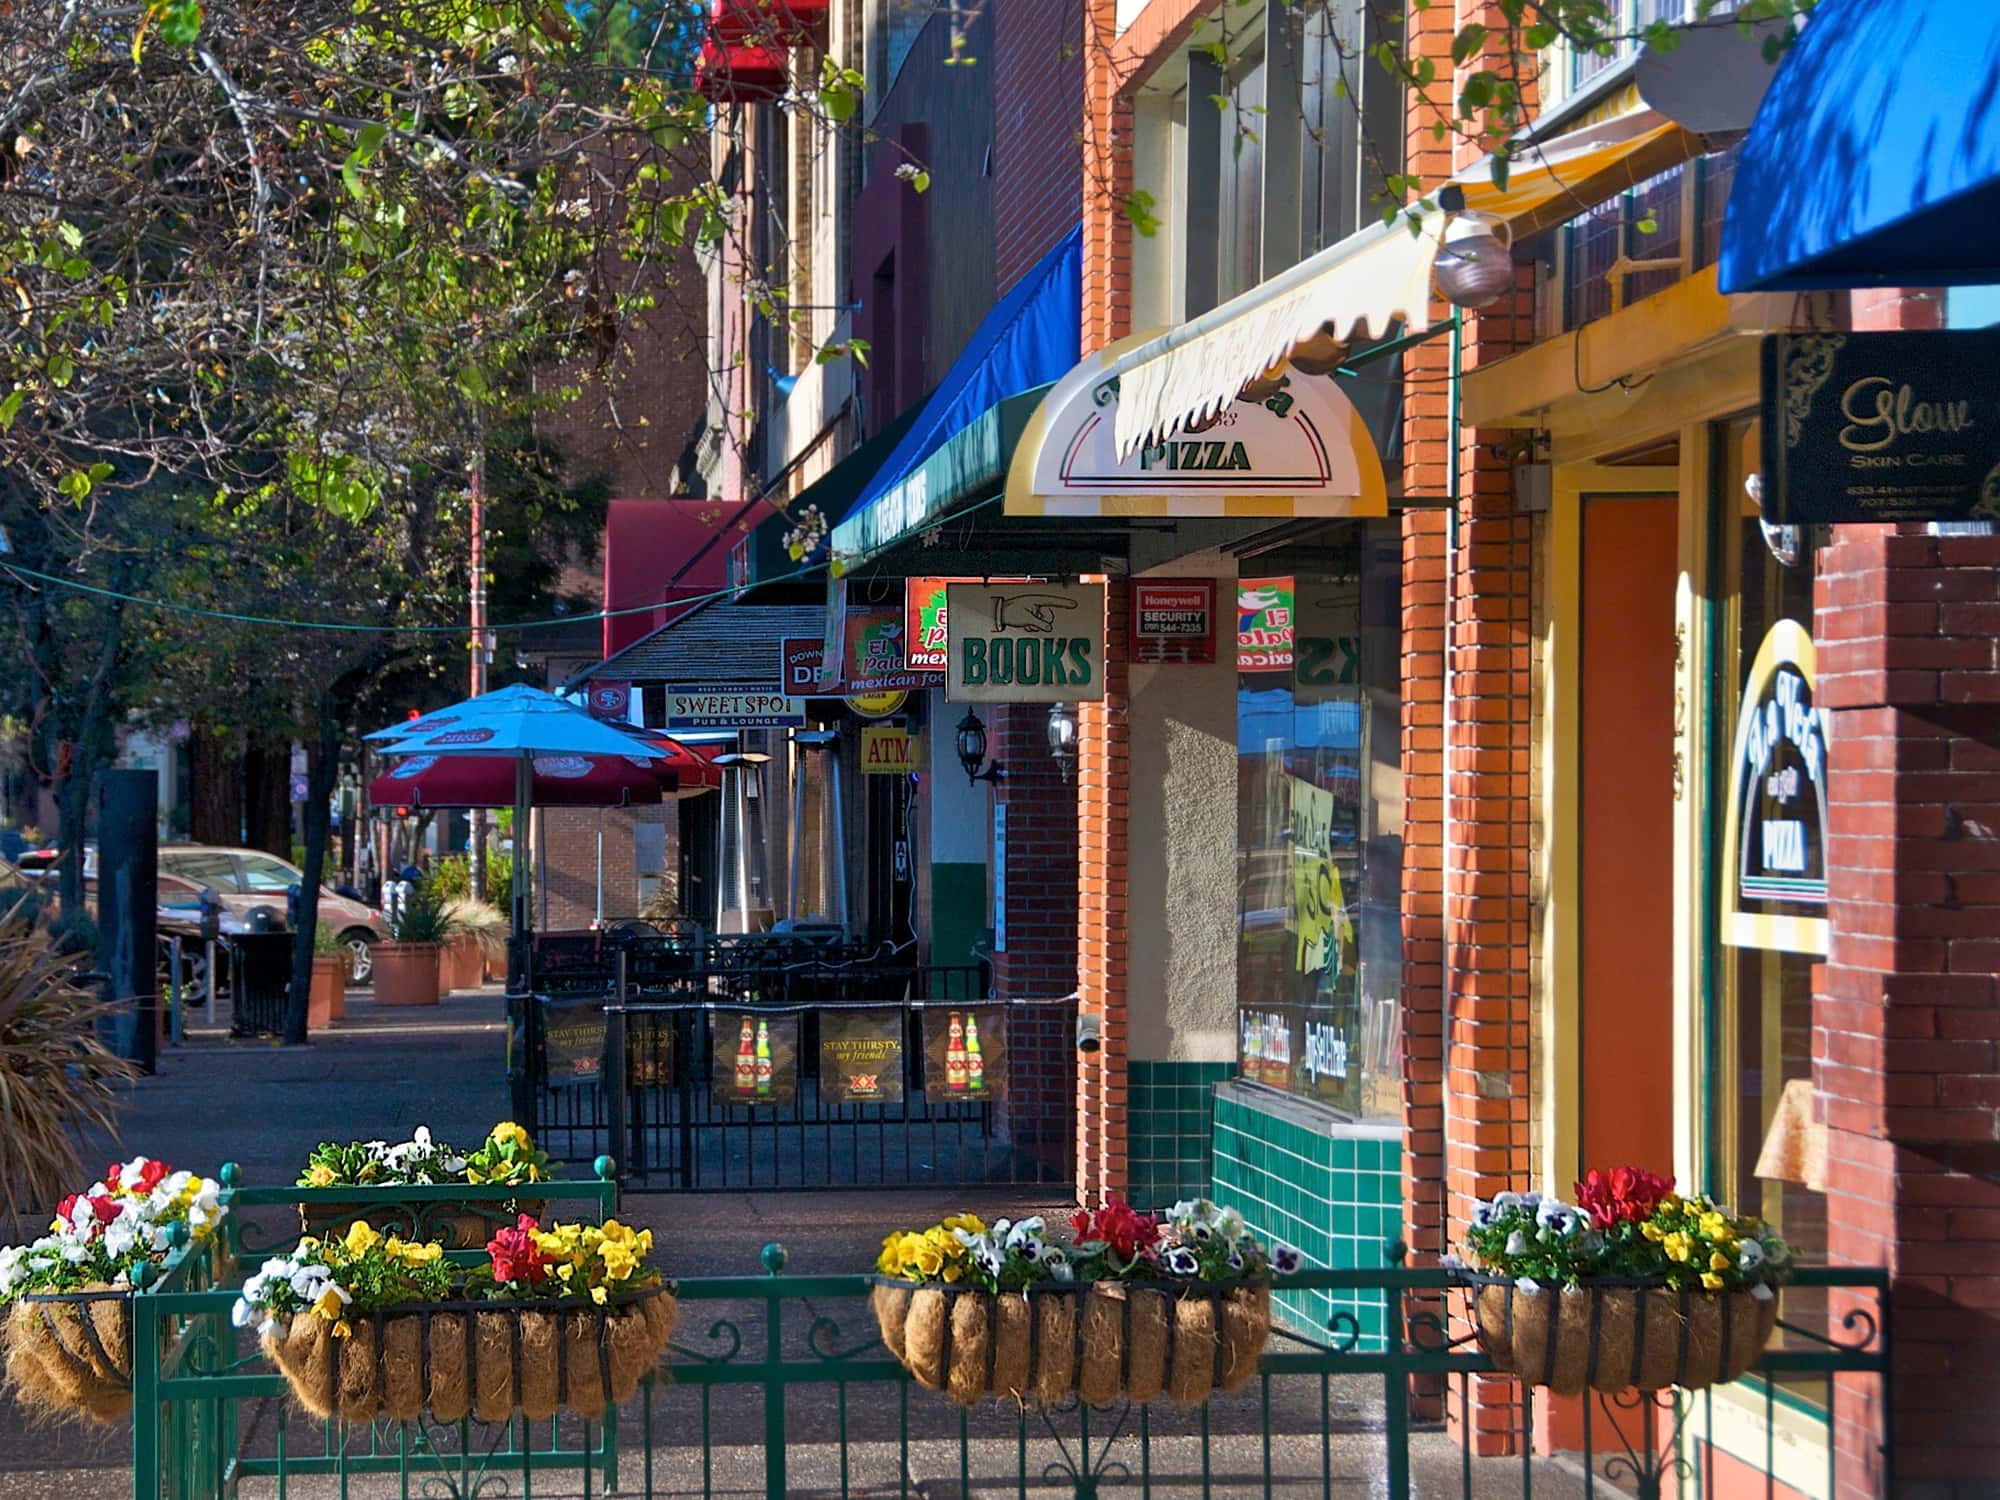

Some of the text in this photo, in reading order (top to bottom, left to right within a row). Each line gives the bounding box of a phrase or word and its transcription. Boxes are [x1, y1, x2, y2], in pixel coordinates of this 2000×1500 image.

[1141, 441, 1251, 470] PIZZA
[1849, 455, 1901, 469] SKIN
[1145, 595, 1201, 607] Honeywell
[1144, 612, 1202, 622] SECURITY
[868, 640, 889, 655] El
[962, 637, 1092, 685] BOOKS
[851, 672, 916, 690] mexican
[675, 696, 743, 715] SWEET
[731, 717, 780, 725] LOUNGE
[868, 736, 914, 764] ATM
[896, 842, 906, 881] ATM
[824, 1041, 849, 1050] STAY
